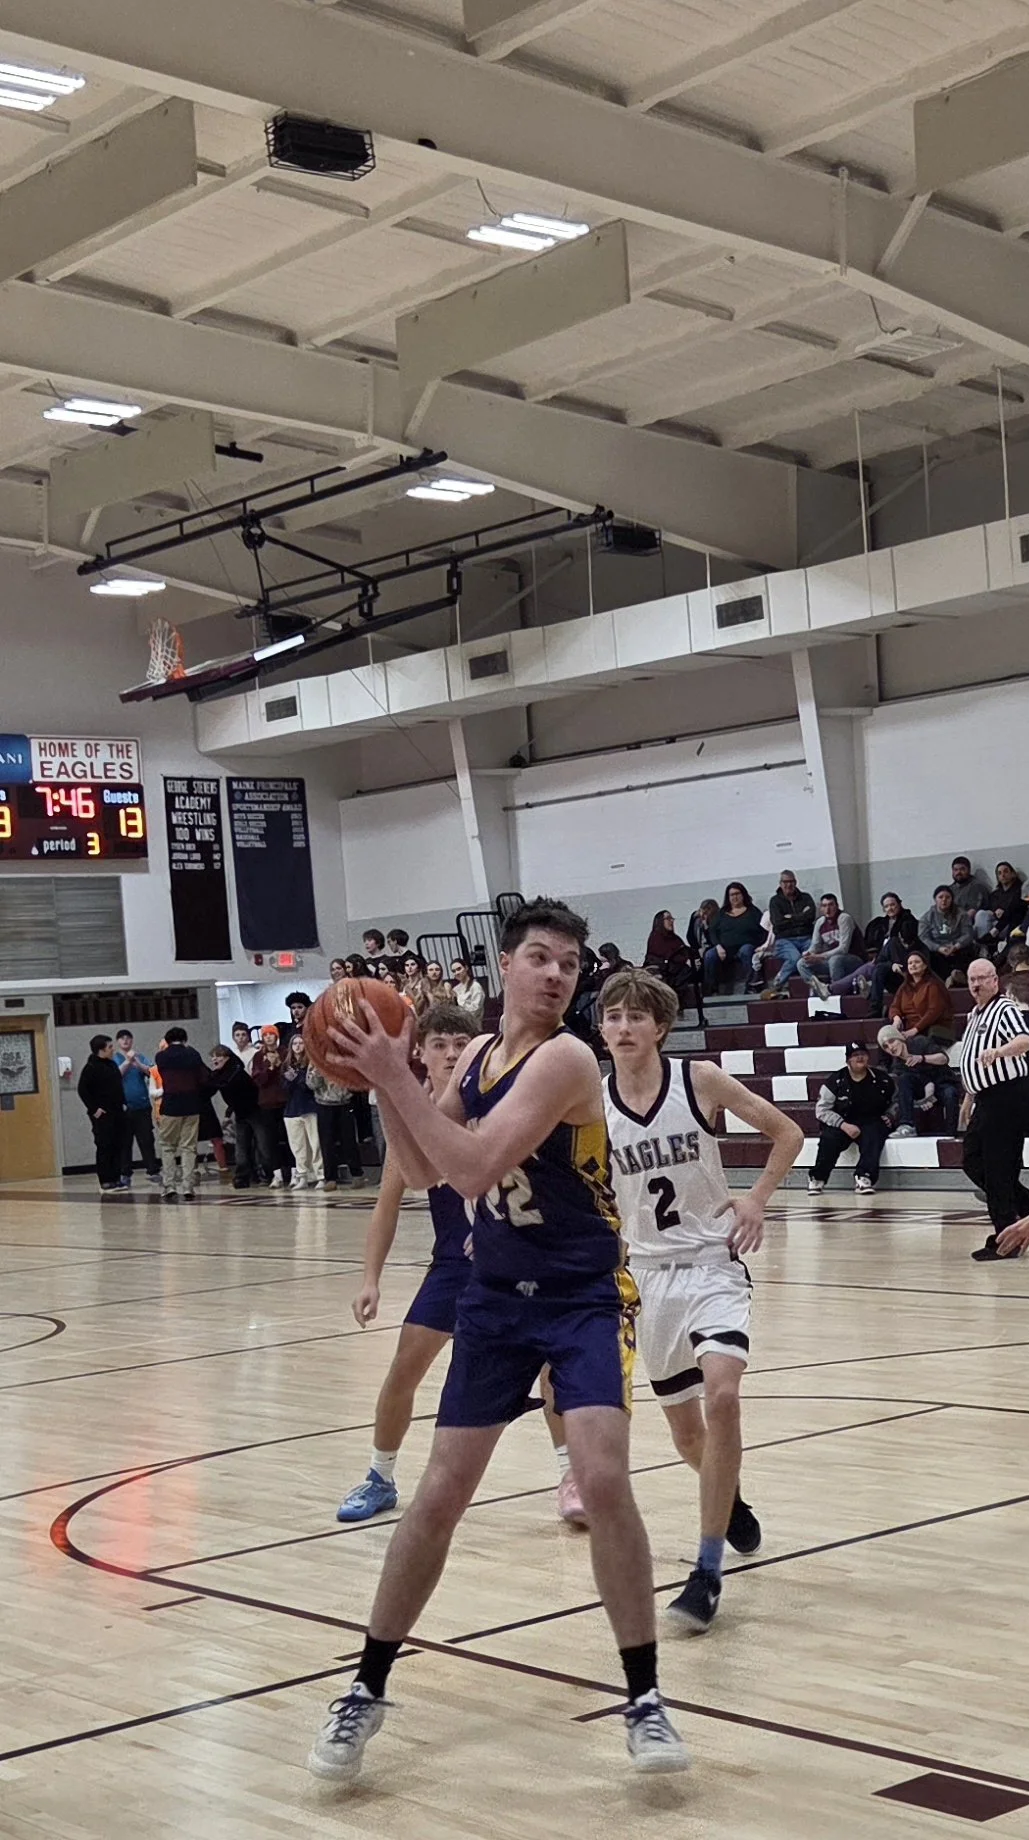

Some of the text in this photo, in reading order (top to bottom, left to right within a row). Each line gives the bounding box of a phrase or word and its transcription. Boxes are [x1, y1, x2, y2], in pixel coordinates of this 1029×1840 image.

[38, 742, 133, 759] HOME OF THE
[40, 761, 133, 780] EAGLES
[35, 786, 95, 818] 7:46
[103, 789, 139, 804] Guests
[175, 796, 211, 809] ACADEMY
[119, 807, 143, 838] 13
[171, 812, 217, 826] WRESTLING
[43, 832, 100, 855] period 3
[195, 828, 215, 841] WINS
[647, 1176, 681, 1231] 2
